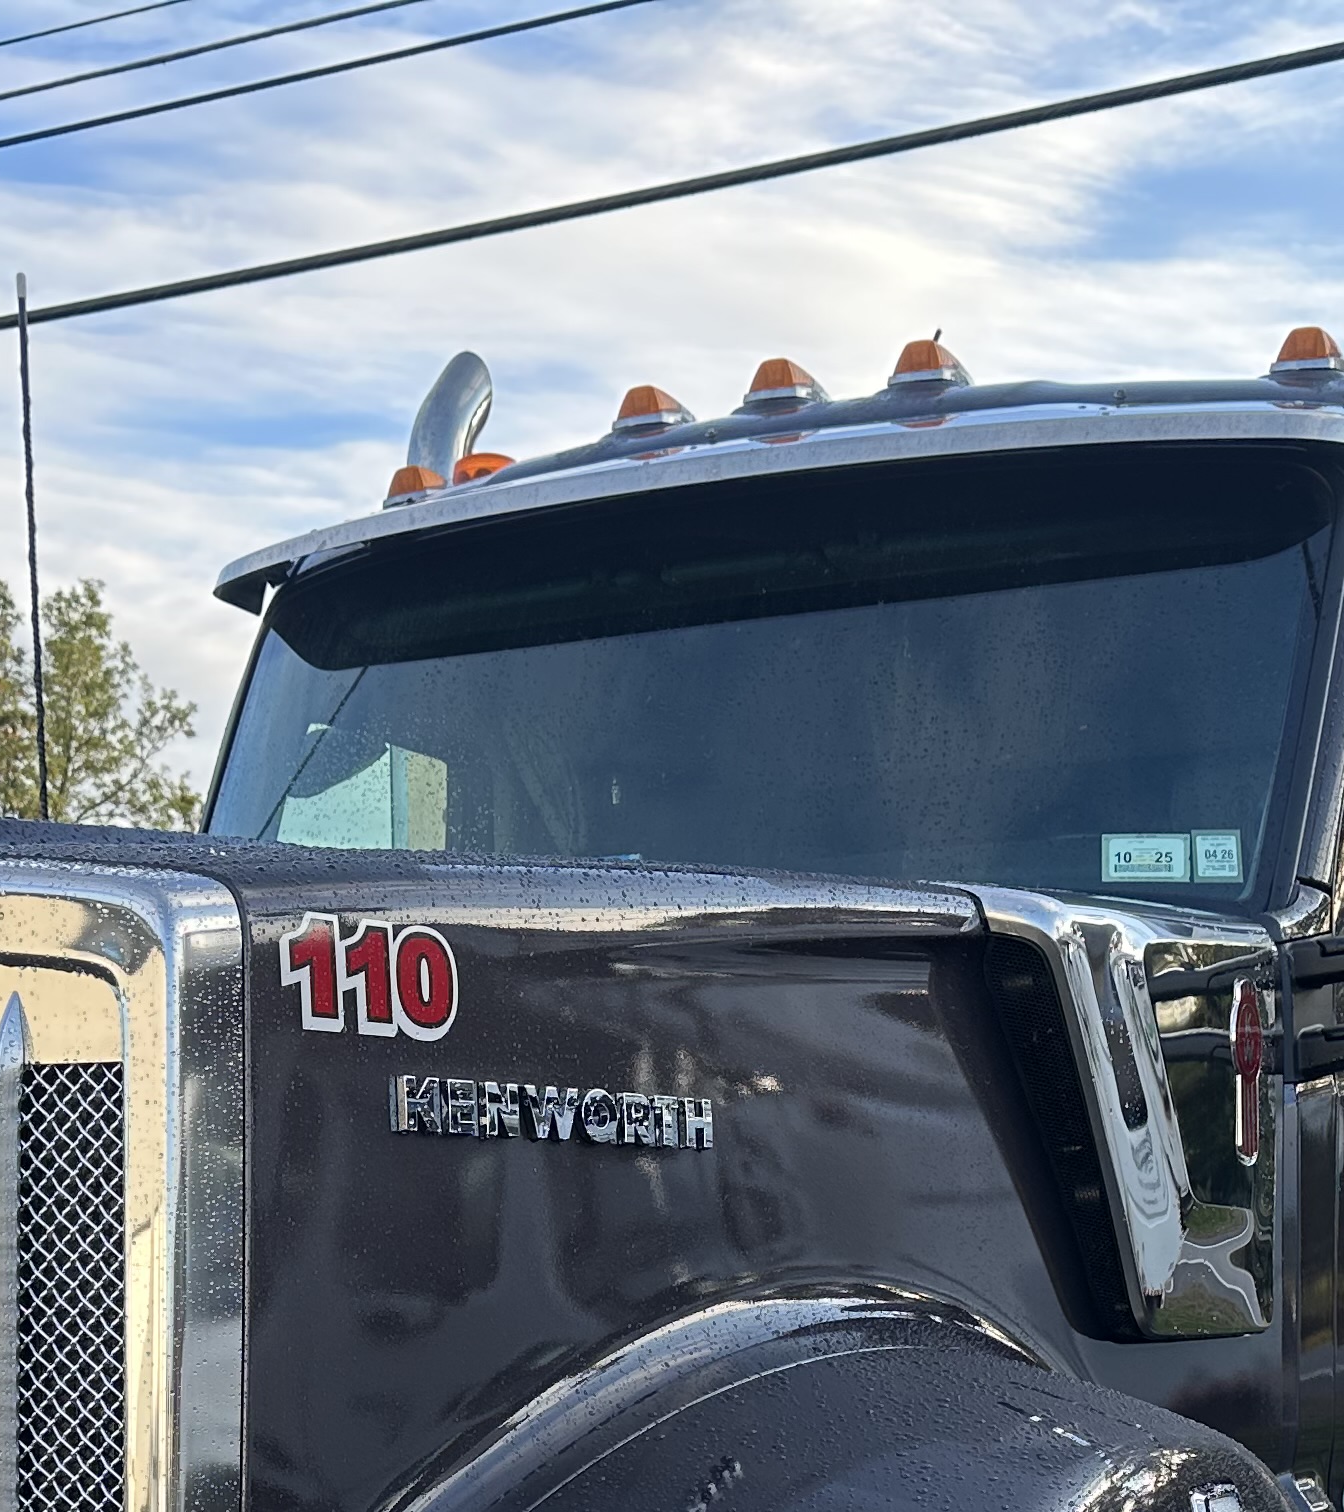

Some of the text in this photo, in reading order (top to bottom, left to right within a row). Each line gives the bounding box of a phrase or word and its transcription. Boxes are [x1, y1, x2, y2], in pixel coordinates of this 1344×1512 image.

[1114, 851, 1132, 864] 10
[1154, 851, 1173, 864] 25
[1204, 848, 1234, 860] 04 26
[279, 911, 459, 1042] 110
[389, 1074, 714, 1150] KENWORTH
